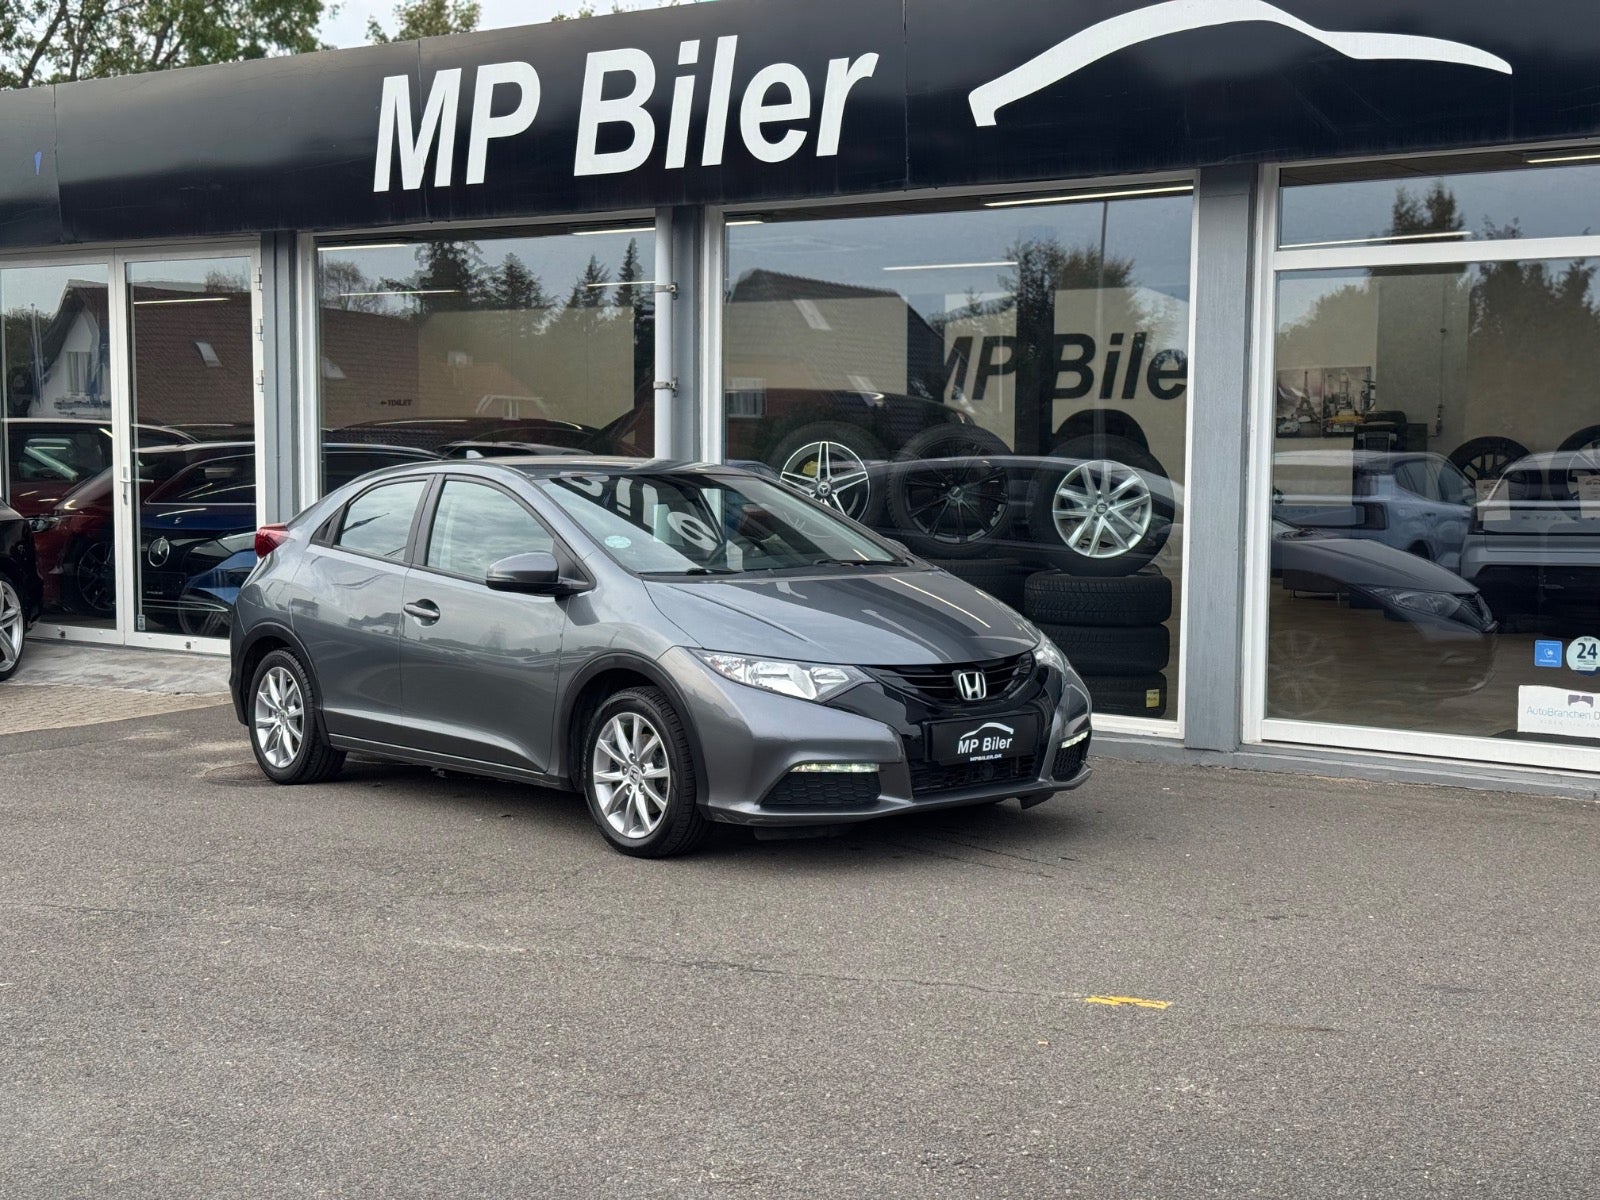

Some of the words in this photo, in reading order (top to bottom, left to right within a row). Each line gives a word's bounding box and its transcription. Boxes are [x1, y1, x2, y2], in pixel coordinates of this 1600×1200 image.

[373, 61, 541, 193] MP
[574, 35, 880, 177] Biler
[1576, 642, 1598, 660] 24
[1527, 706, 1591, 720] AutoBranchen
[957, 739, 979, 755] MP
[982, 736, 1013, 752] Biler
